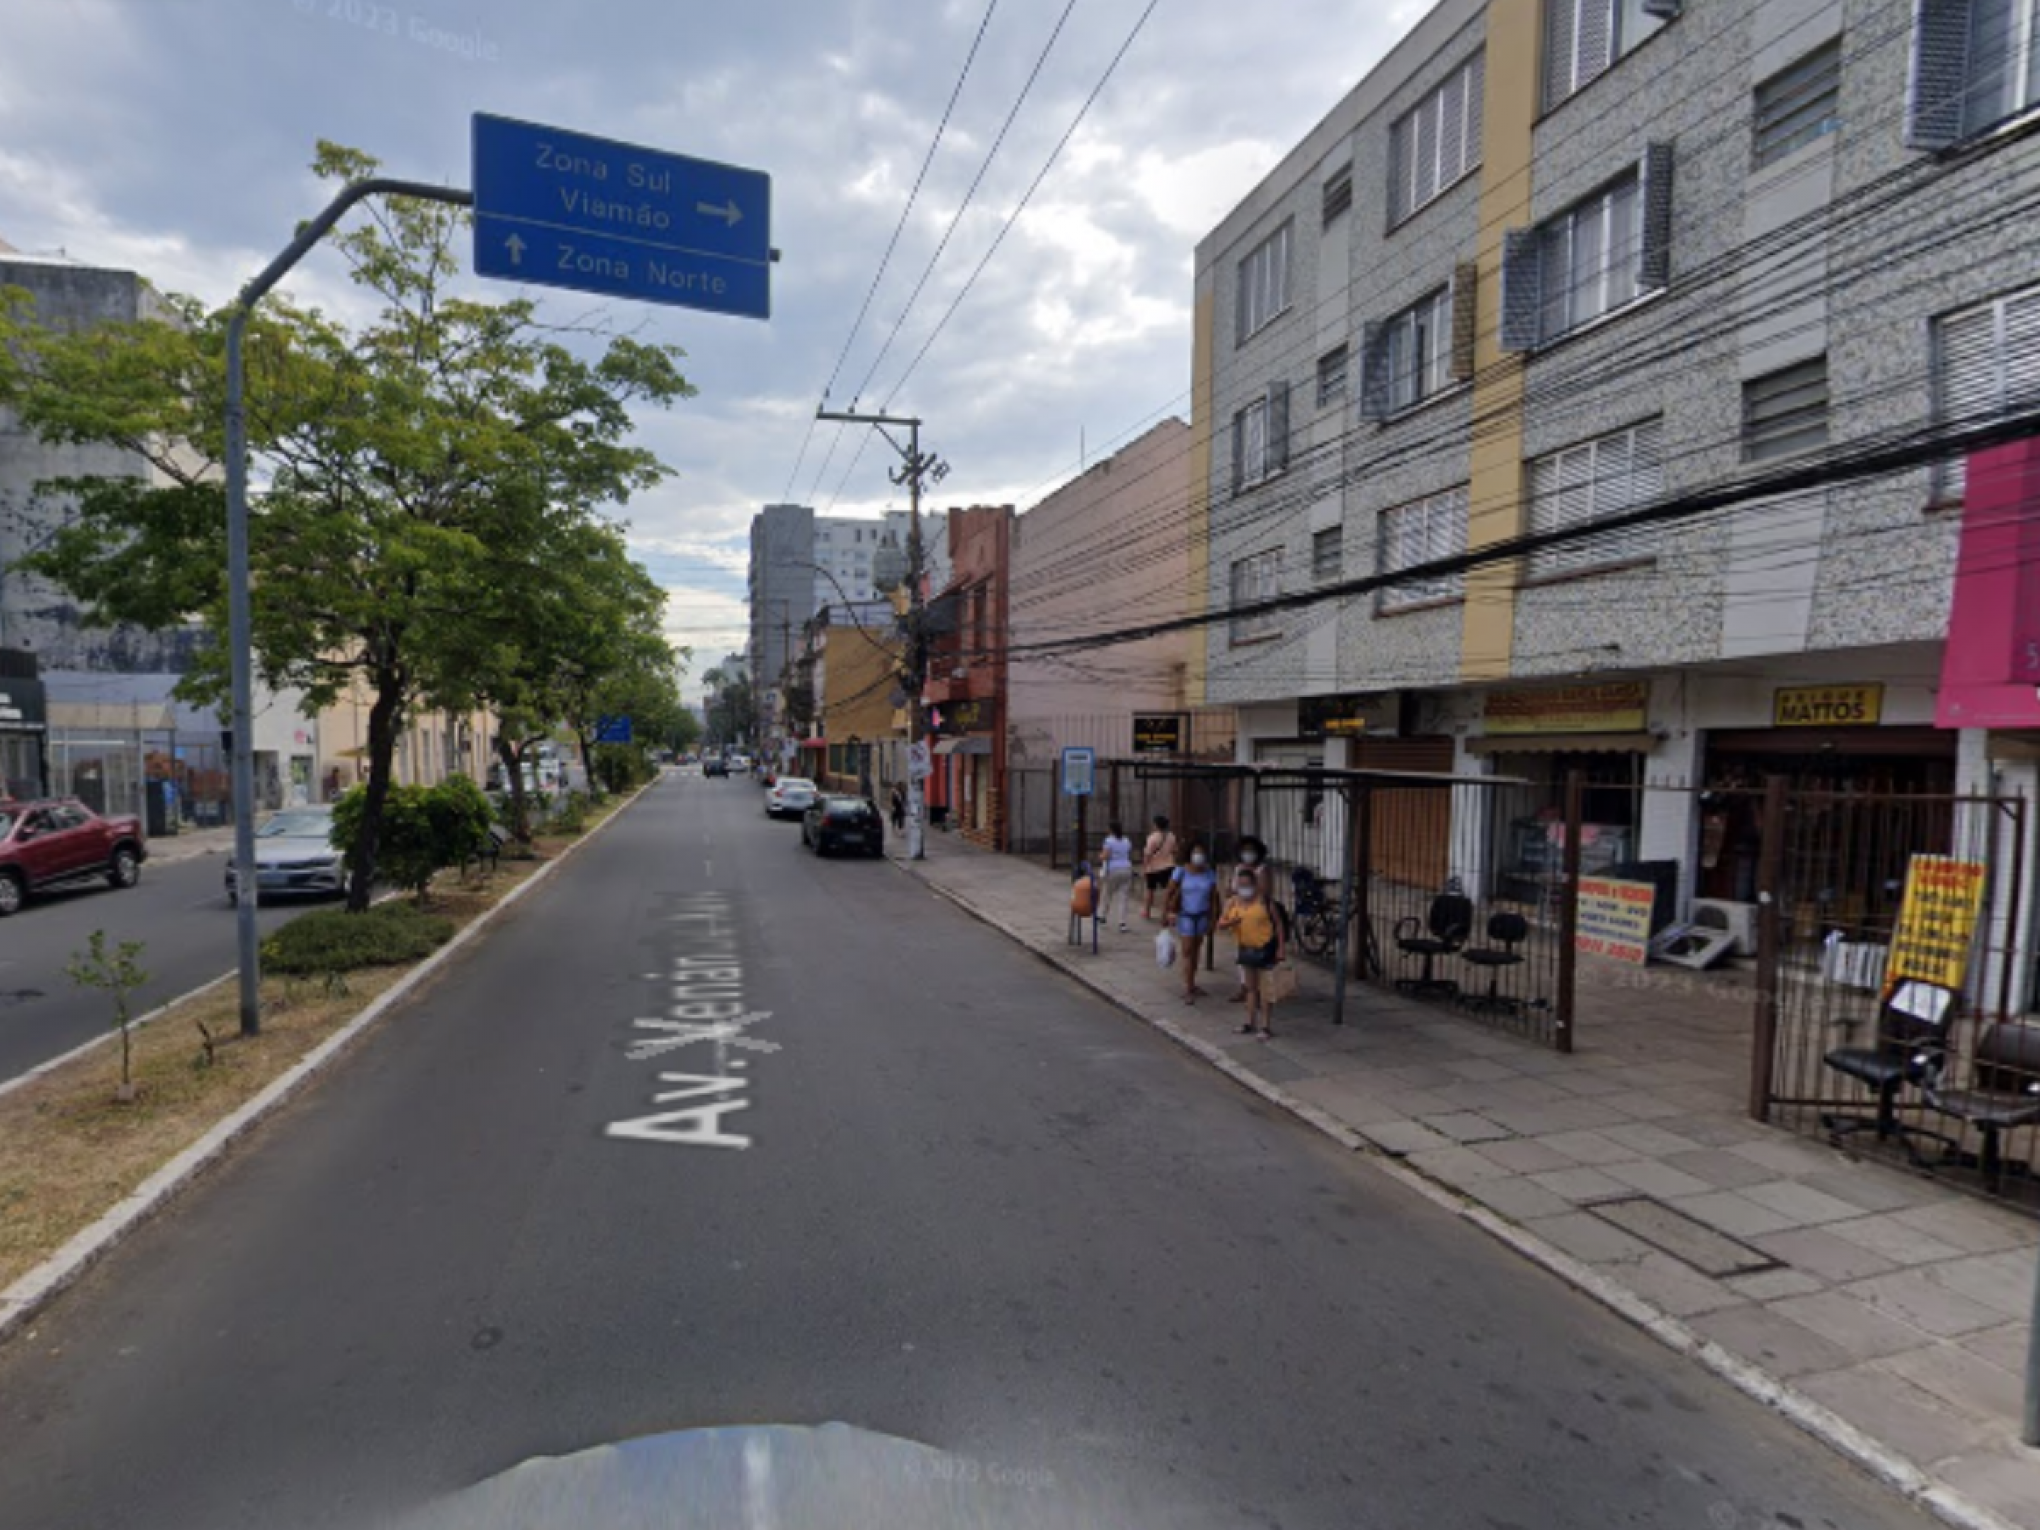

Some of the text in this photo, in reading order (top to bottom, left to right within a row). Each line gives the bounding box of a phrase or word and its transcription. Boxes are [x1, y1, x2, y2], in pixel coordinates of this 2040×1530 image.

[536, 143, 671, 195] Zona Sul
[559, 187, 671, 229] Viamão
[558, 245, 727, 294] Zona Norte
[1780, 702, 1866, 723] MATTOS
